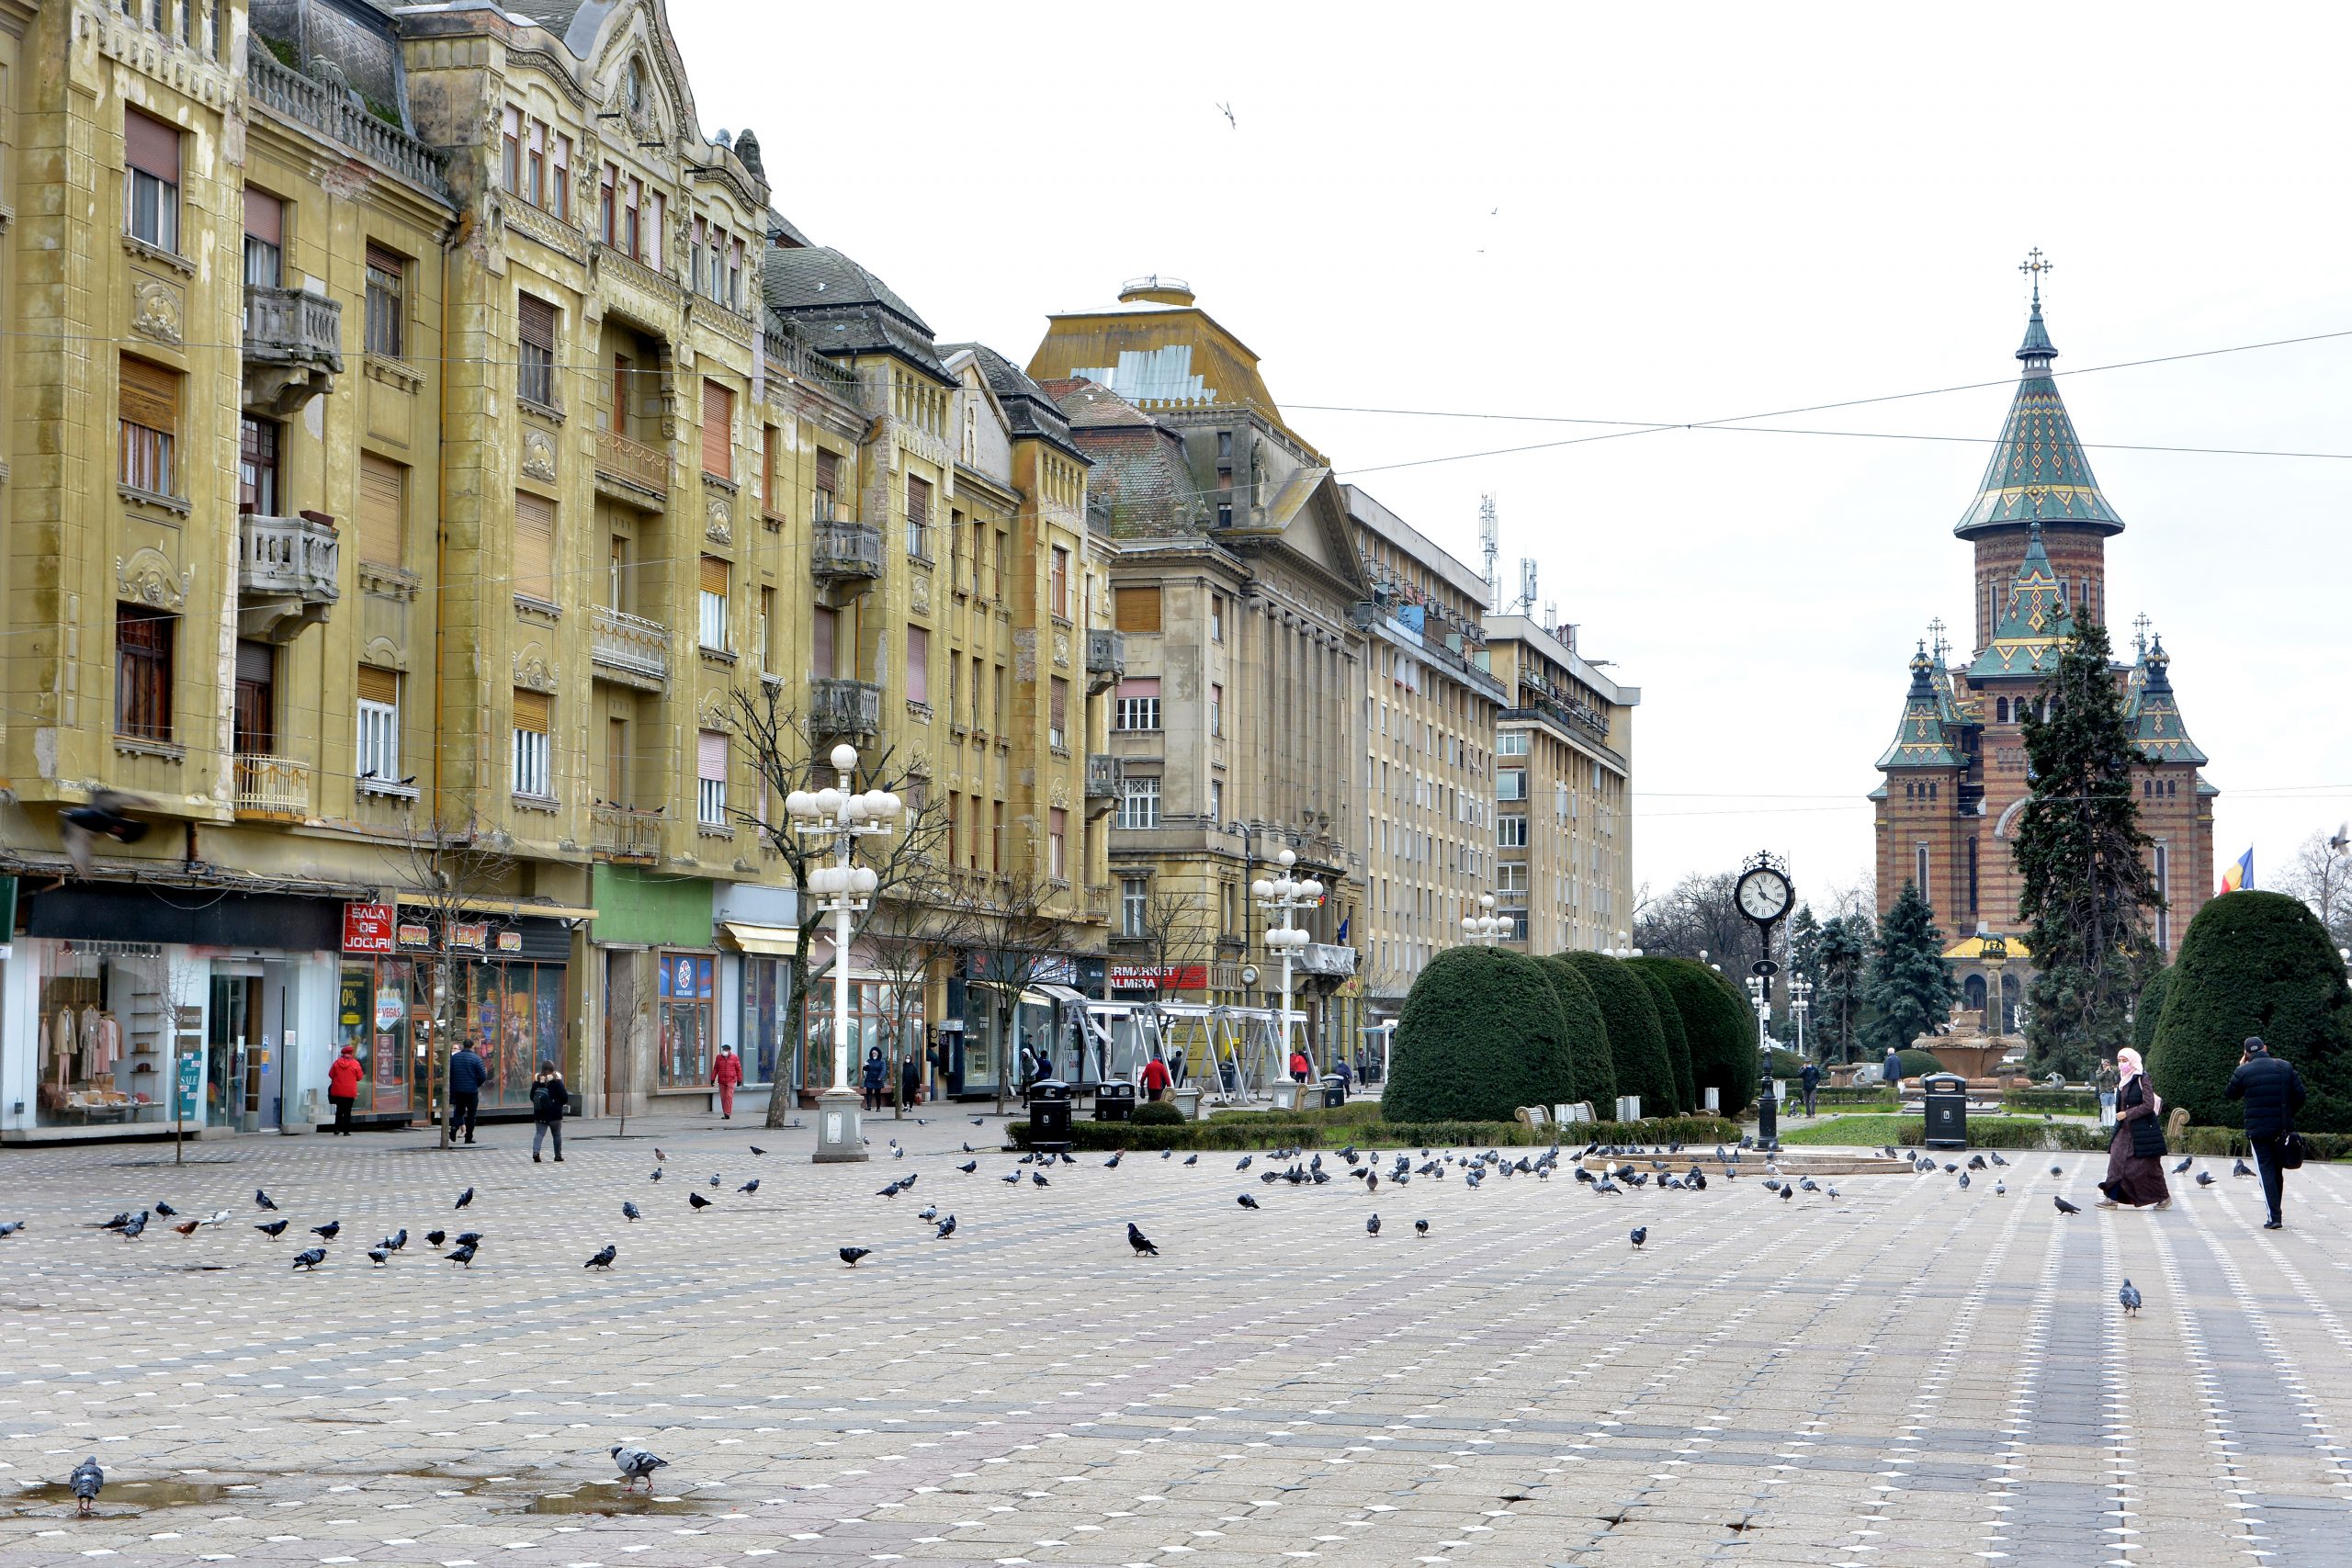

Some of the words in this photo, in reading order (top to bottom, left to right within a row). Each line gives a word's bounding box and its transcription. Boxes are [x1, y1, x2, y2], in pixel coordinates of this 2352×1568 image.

[352, 908, 386, 919] SALA
[359, 922, 378, 933] DE
[443, 921, 487, 952] ACKPOT
[345, 937, 390, 949] JOCURI
[1111, 978, 1156, 988] ALMIRA
[382, 1008, 401, 1019] VEGAS
[180, 1075, 198, 1085] SALE
